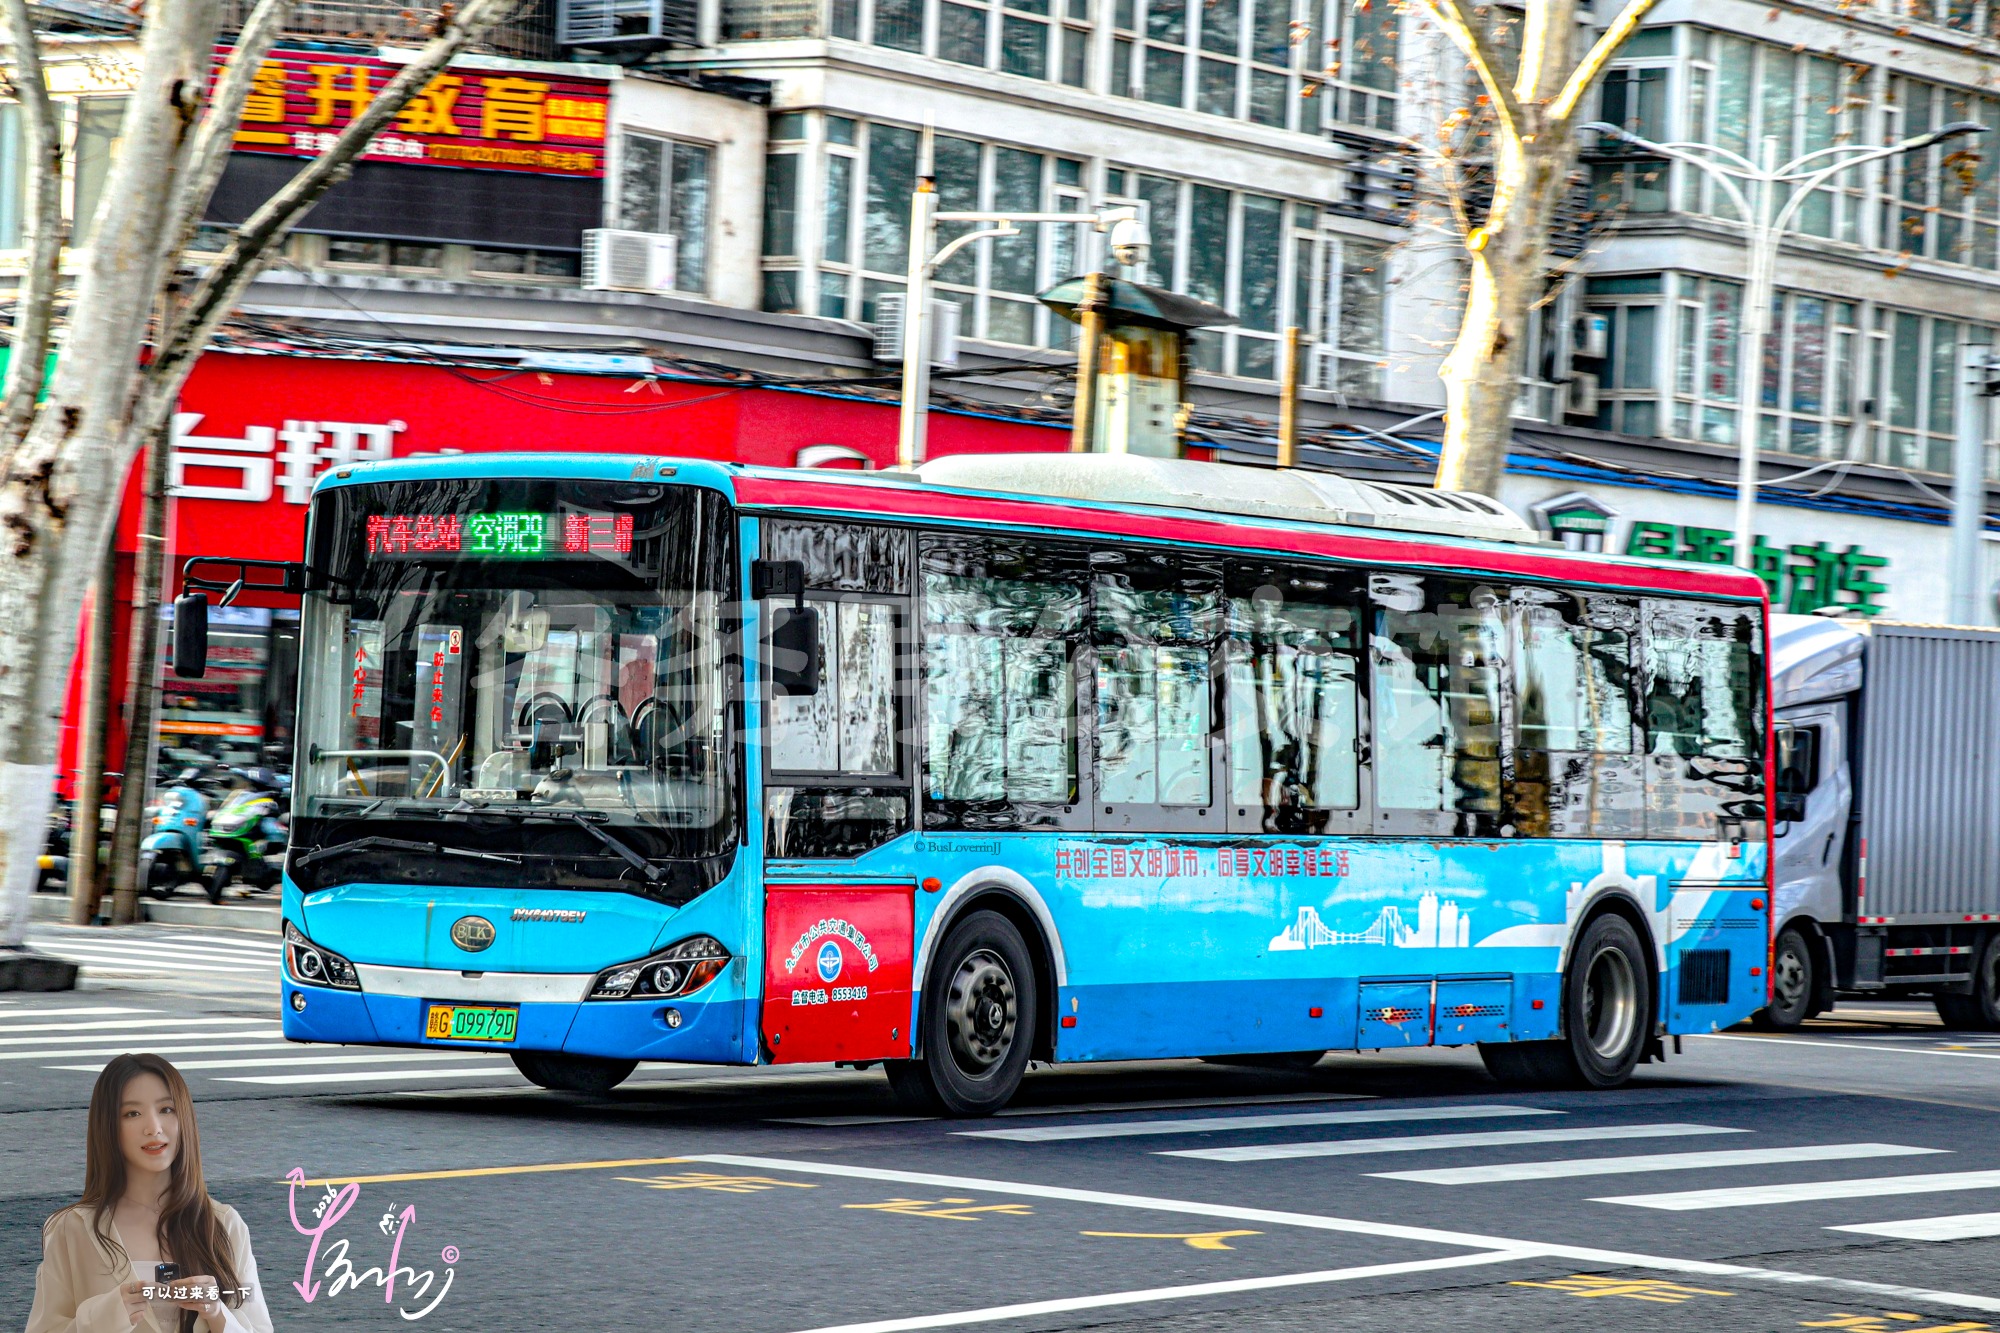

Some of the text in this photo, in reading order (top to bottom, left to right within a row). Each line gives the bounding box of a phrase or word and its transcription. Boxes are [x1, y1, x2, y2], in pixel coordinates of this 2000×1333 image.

[366, 514, 461, 553] 汽车总站
[785, 918, 879, 974] 九江市公共交通集团公司
